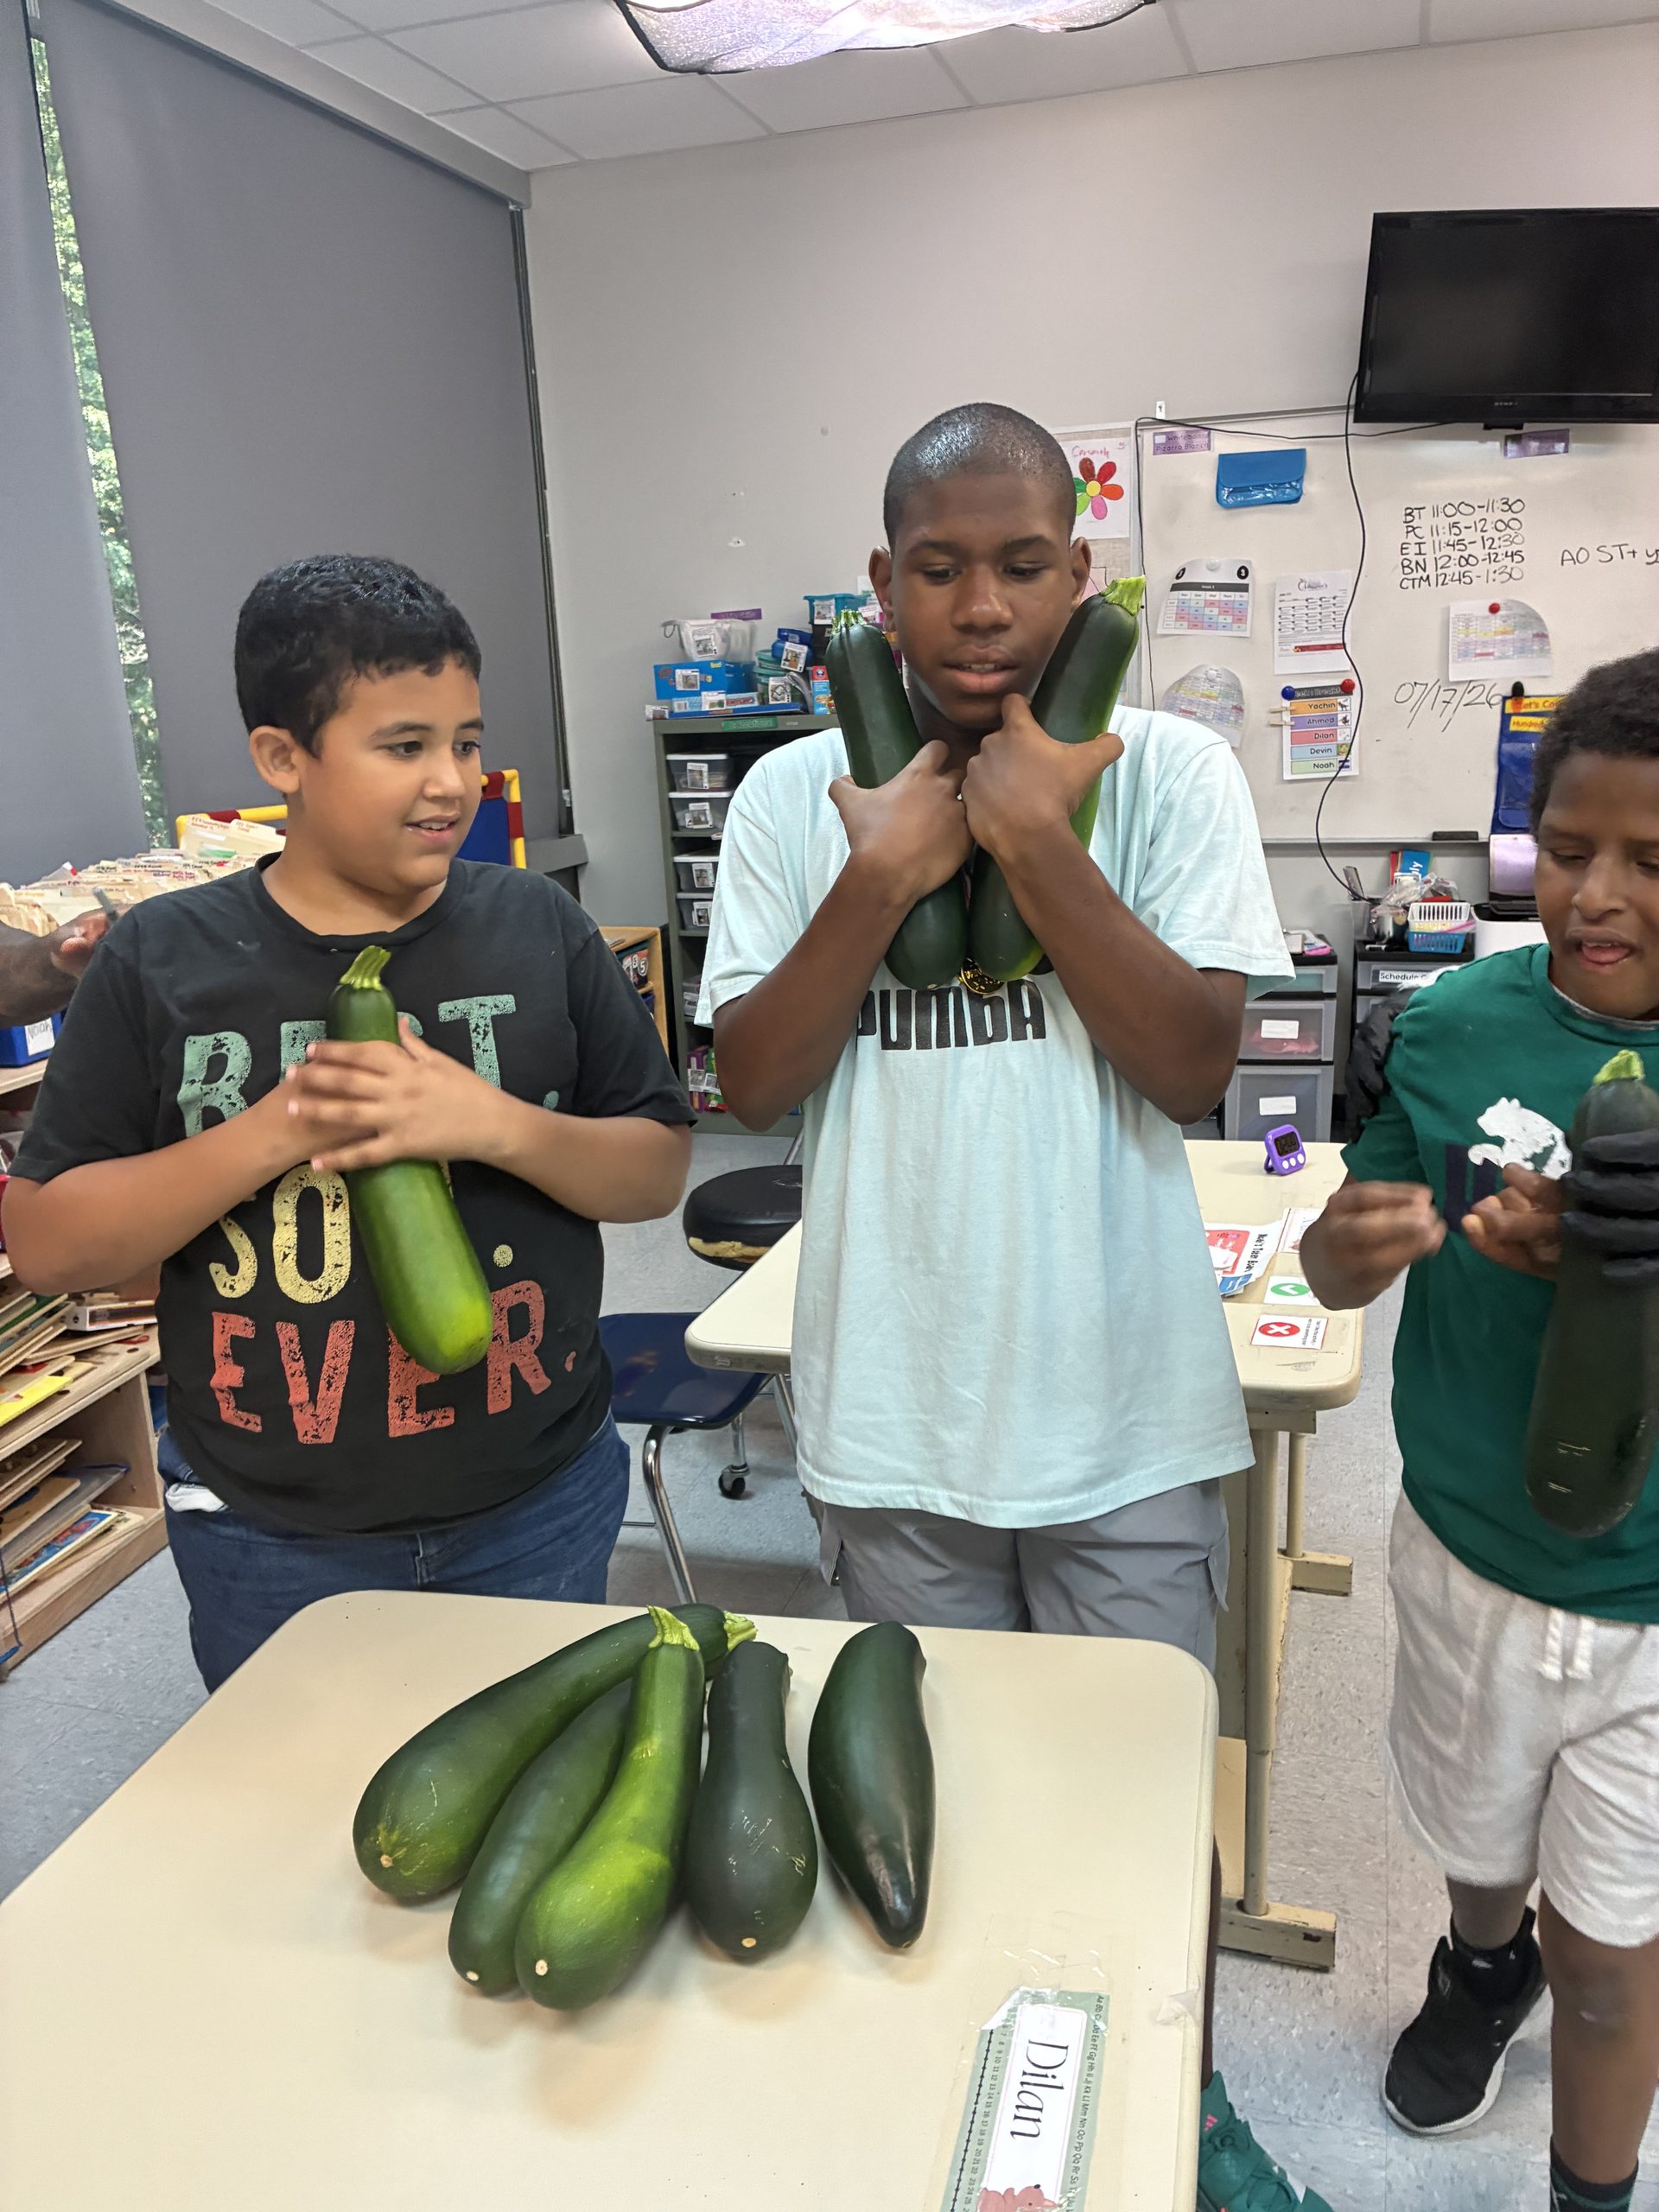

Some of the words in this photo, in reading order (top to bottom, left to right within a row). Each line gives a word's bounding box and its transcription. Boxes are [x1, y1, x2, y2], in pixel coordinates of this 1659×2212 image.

[1403, 506, 1426, 524] BT
[1405, 525, 1424, 539] PC
[1401, 558, 1427, 575] BN
[1399, 574, 1431, 589] CTM
[1394, 678, 1503, 733] 07/17/26
[1310, 746, 1332, 754] Devin
[1096, 1995, 1104, 2004] Aa
[1095, 2005, 1103, 2013] Bb
[1091, 2035, 1099, 2044] Ee
[1090, 2044, 1098, 2052] Ff
[1086, 2051, 1096, 2063] Gg
[1087, 2061, 1095, 2072] Hh
[1084, 2078, 1093, 2087] Jj
[1009, 2038, 1069, 2140] Dilan
[1084, 2086, 1092, 2096] Kk
[1080, 2103, 1090, 2118] Mm
[1078, 2118, 1087, 2129] Nn
[1077, 2129, 1085, 2140] Oo
[1074, 2141, 1084, 2152] Pp
[1072, 2152, 1082, 2164] Qq
[1071, 2165, 1079, 2174] Rr
[1070, 2175, 1078, 2185] Ss
